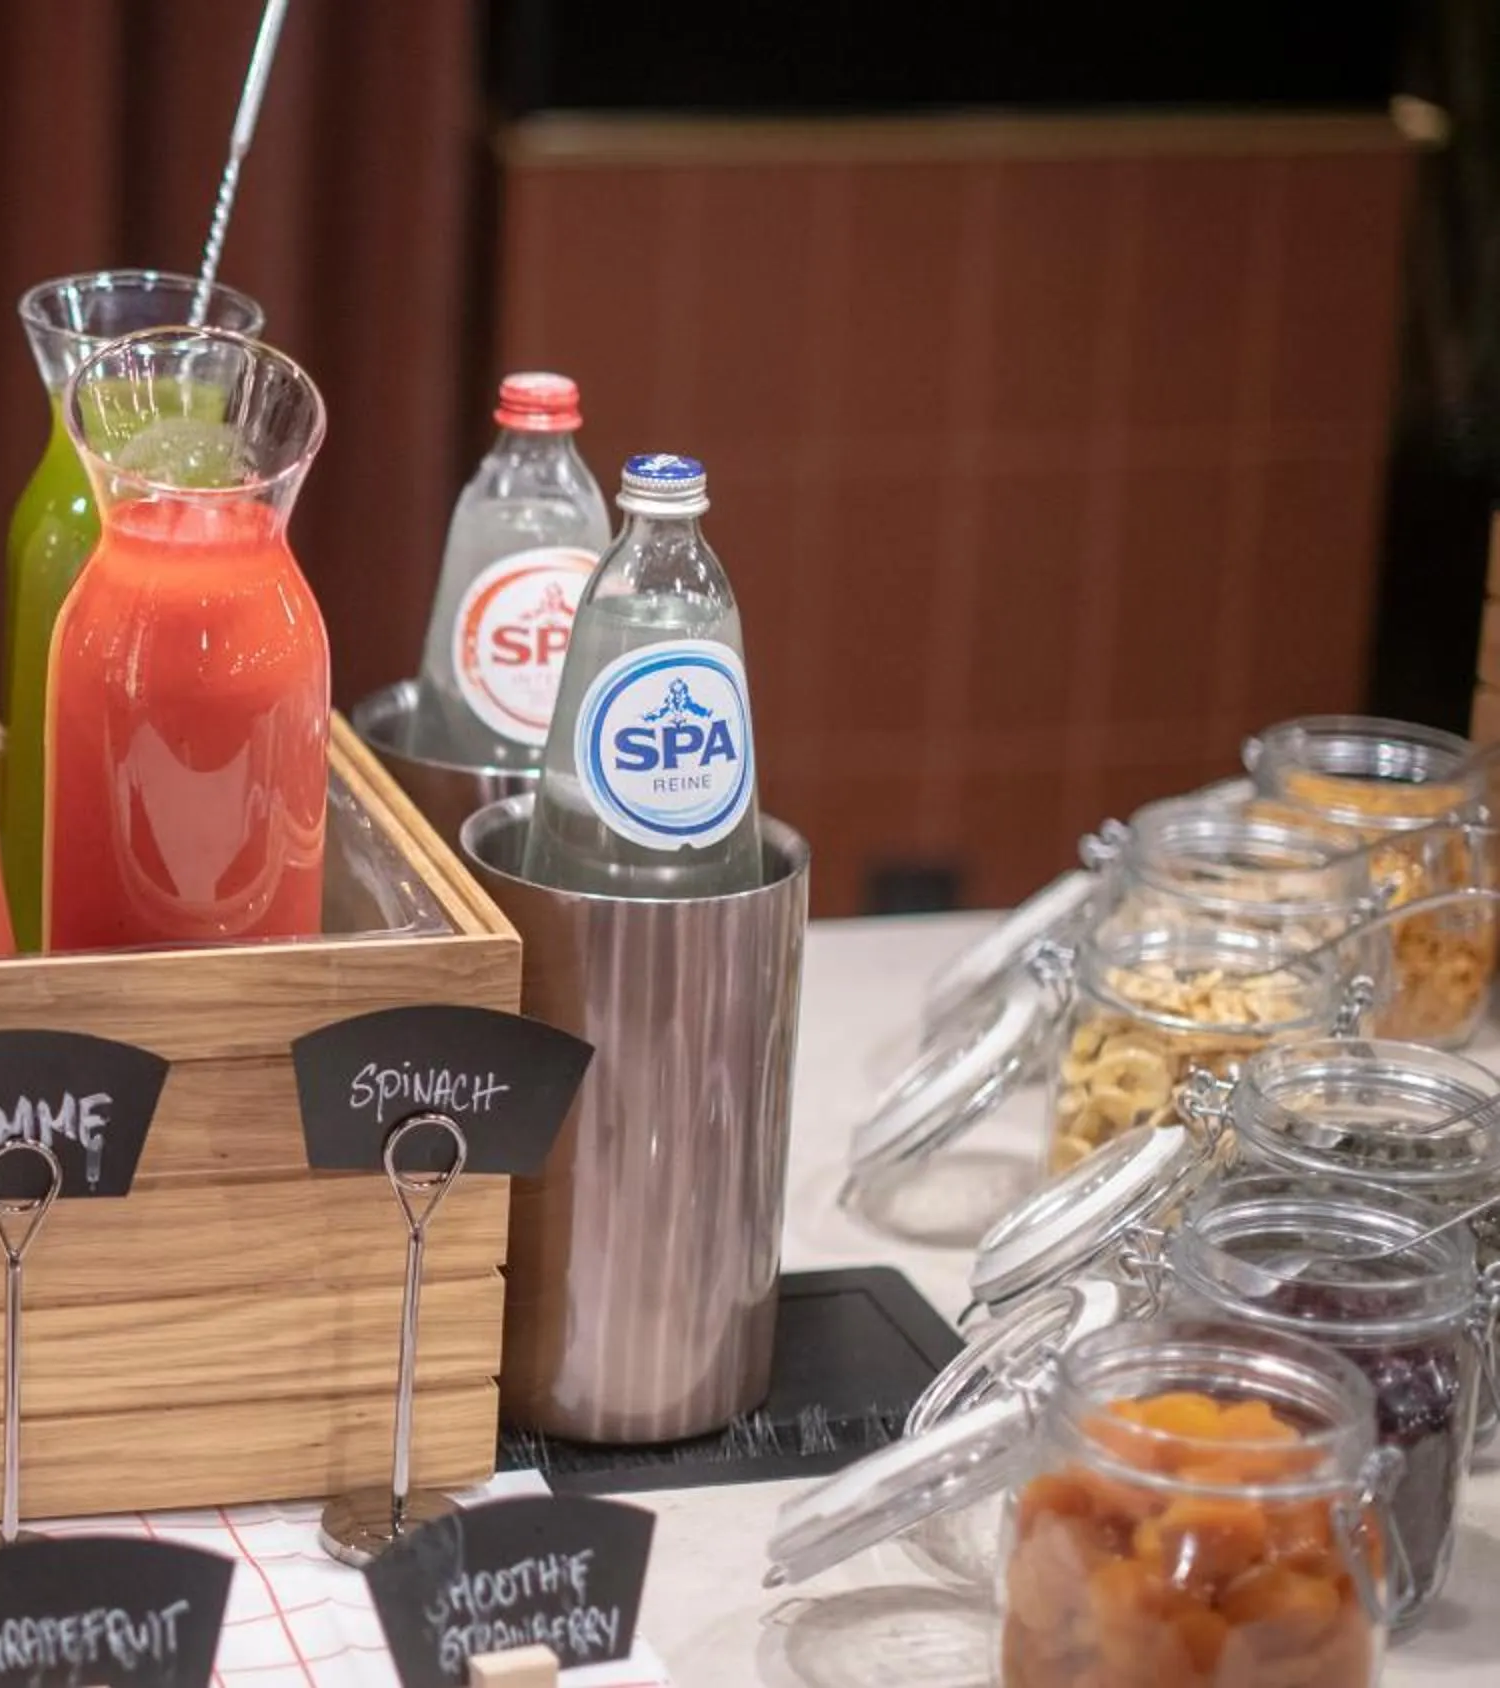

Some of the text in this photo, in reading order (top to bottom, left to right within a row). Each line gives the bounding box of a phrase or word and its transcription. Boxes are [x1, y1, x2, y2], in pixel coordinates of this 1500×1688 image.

[491, 623, 571, 667] SP
[614, 719, 737, 772] SPA
[653, 774, 712, 793] REINE
